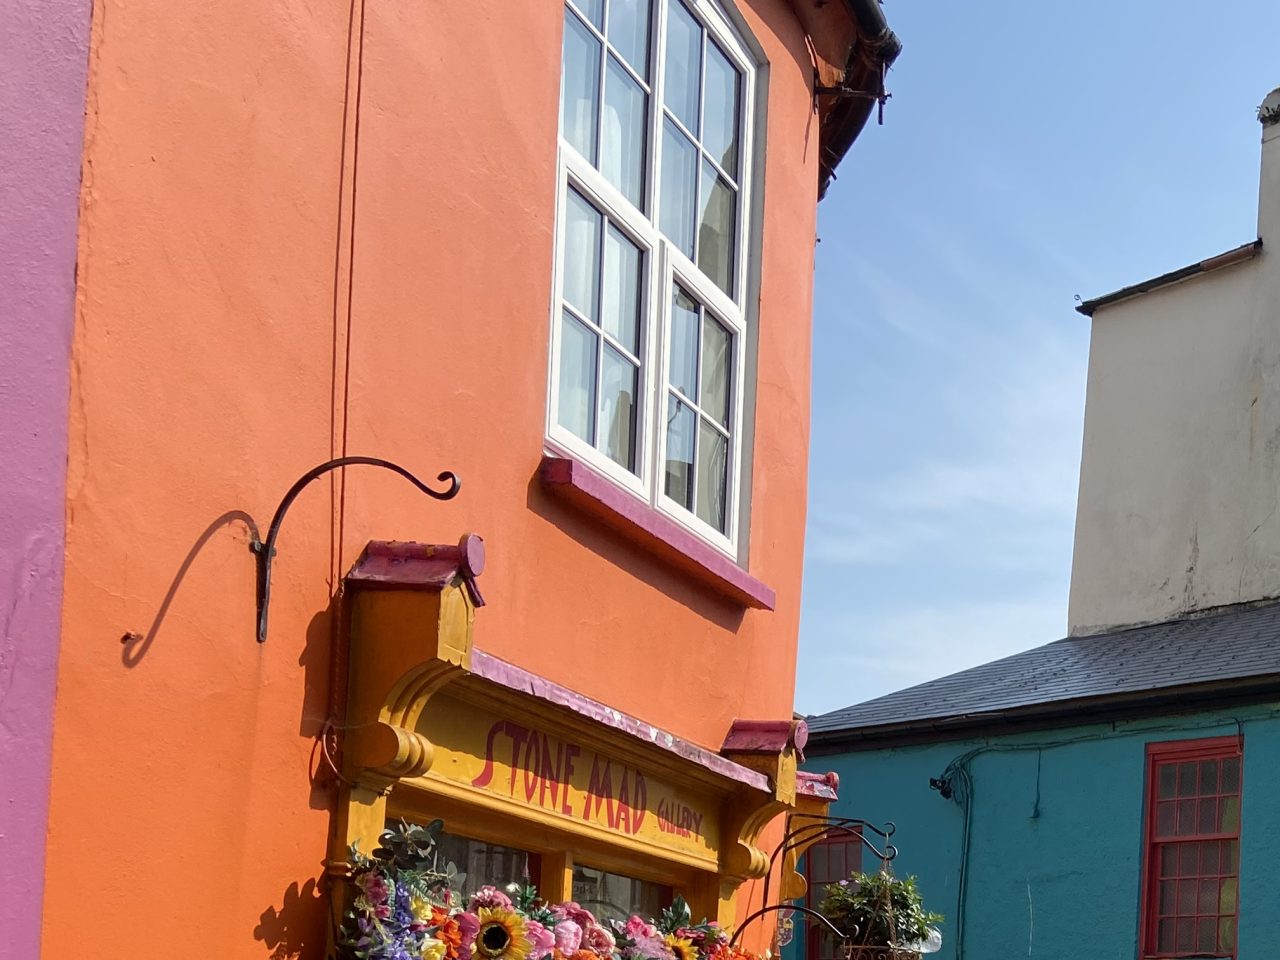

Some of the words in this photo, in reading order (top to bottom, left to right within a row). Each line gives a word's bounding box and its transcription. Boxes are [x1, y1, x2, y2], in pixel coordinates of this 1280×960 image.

[472, 719, 582, 817] STONE
[583, 753, 647, 836] MAD
[657, 798, 704, 843] GALLERY
